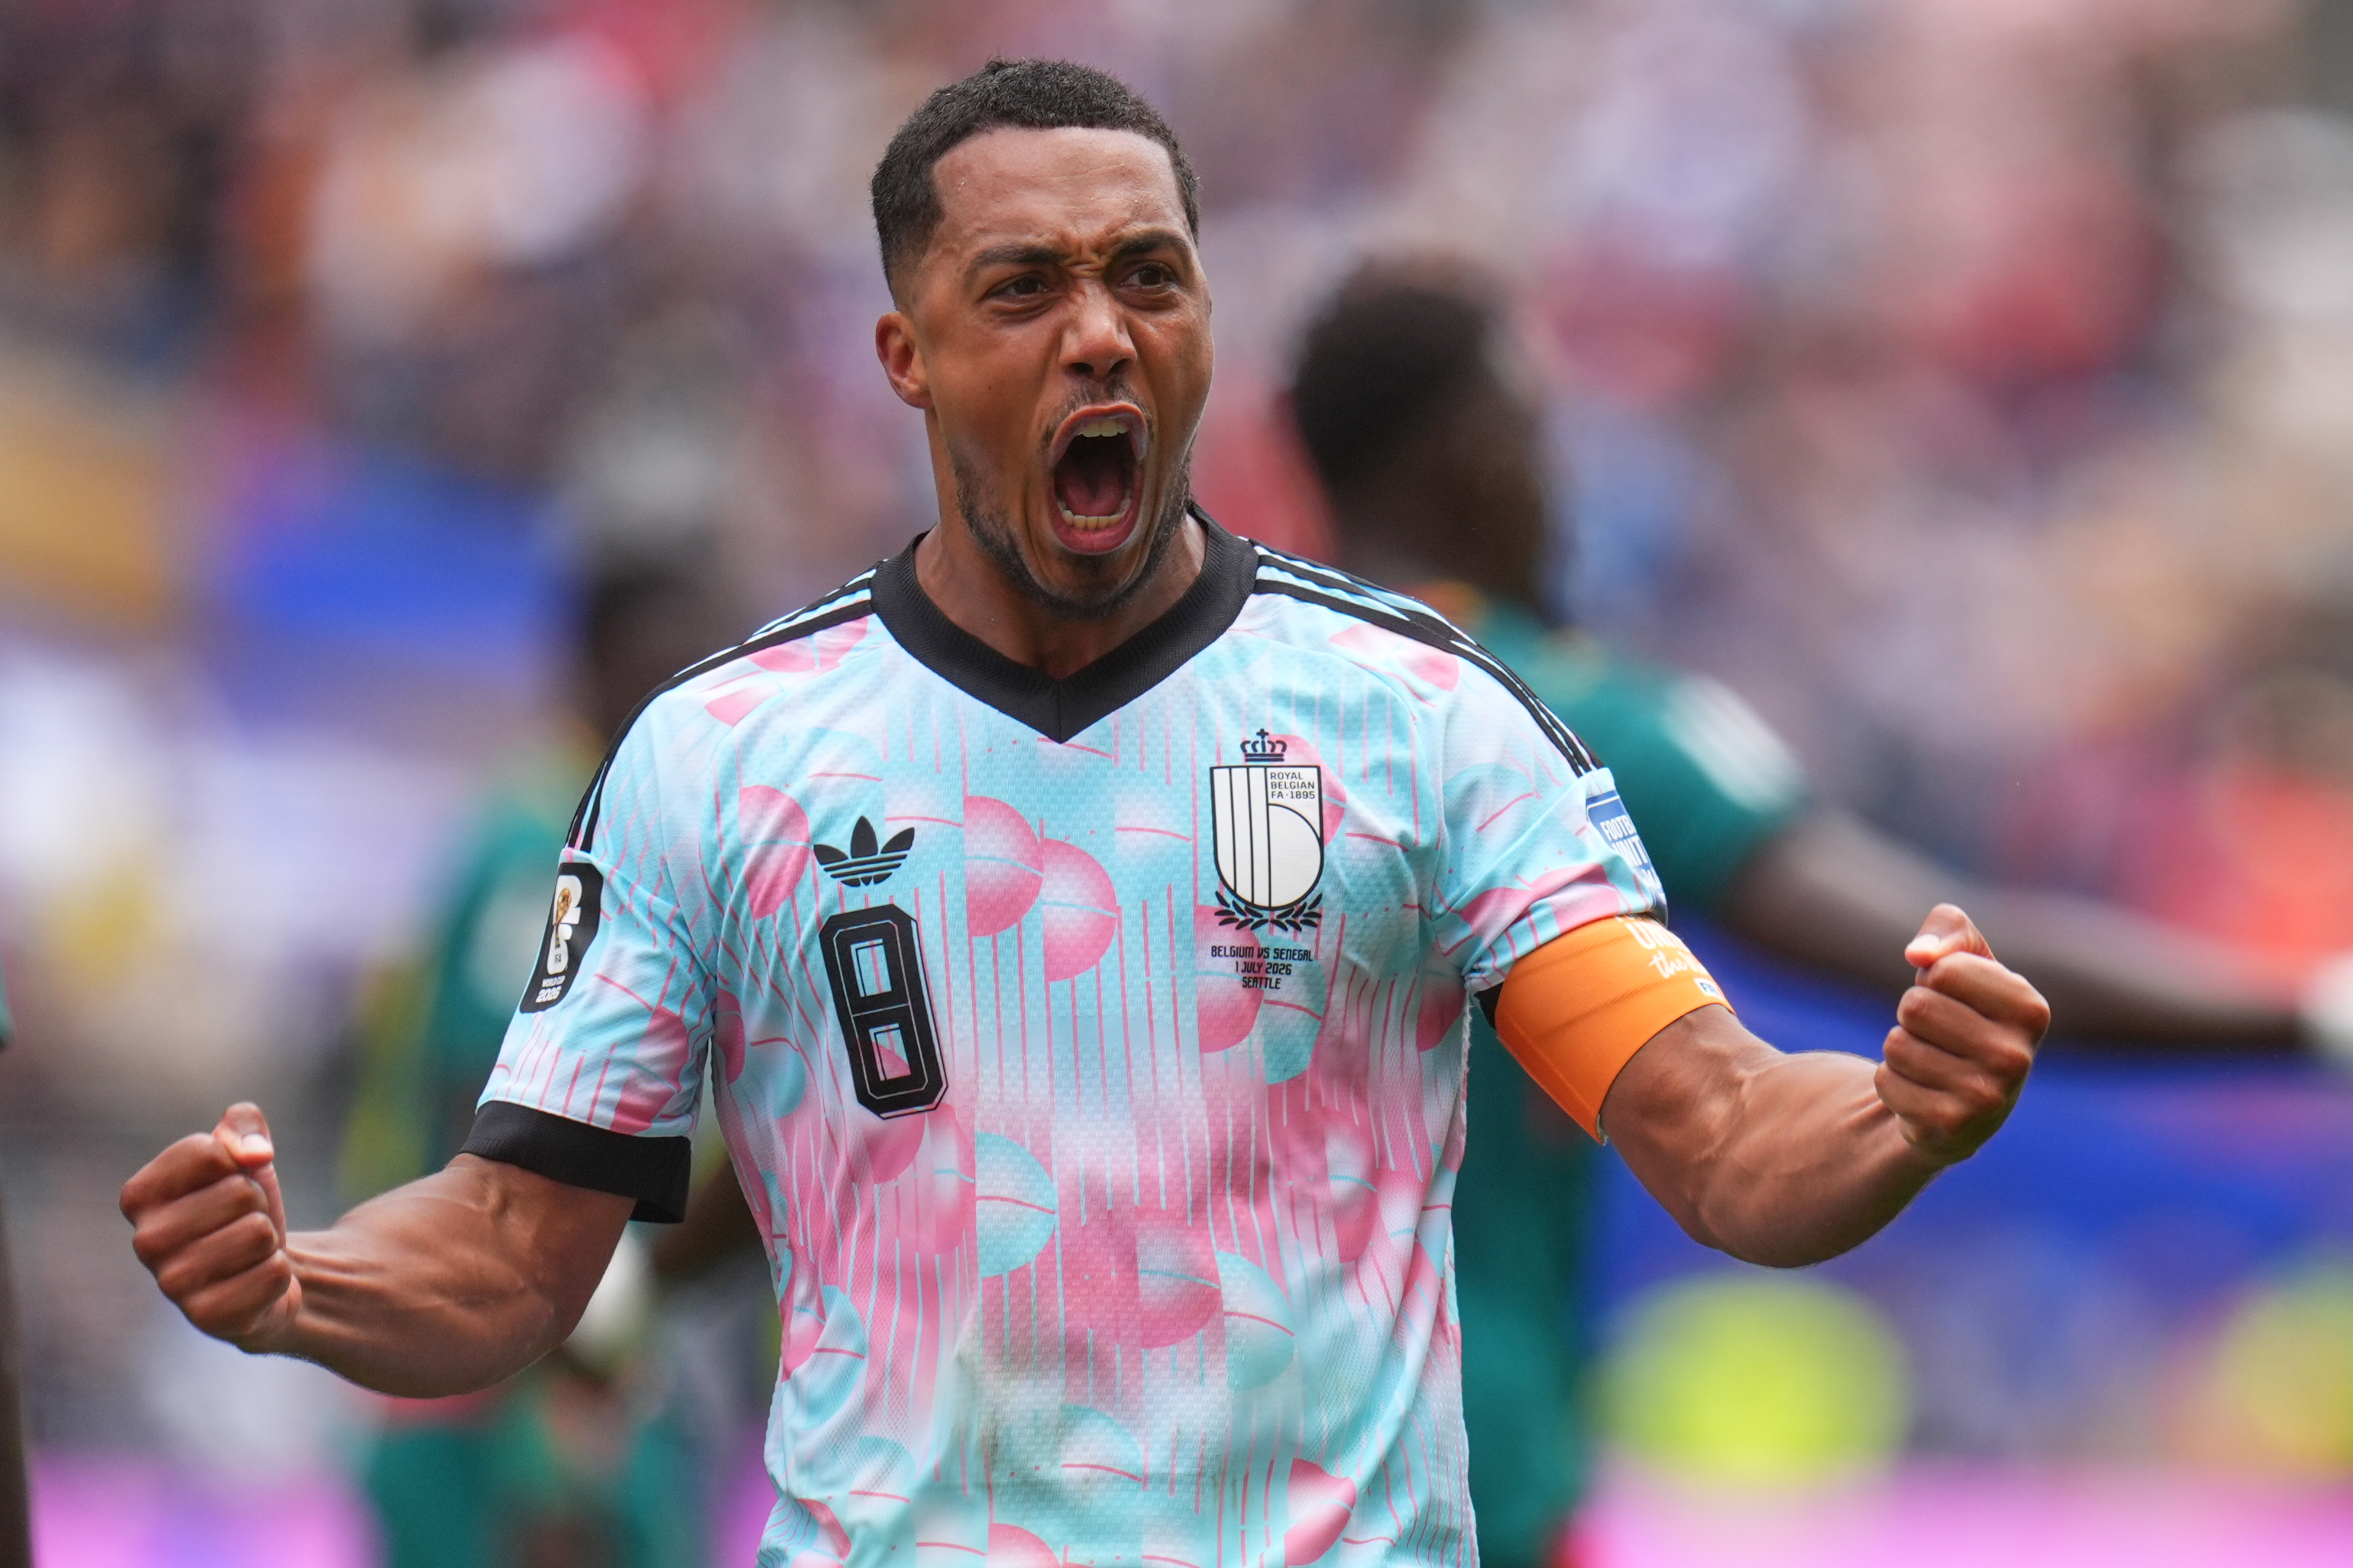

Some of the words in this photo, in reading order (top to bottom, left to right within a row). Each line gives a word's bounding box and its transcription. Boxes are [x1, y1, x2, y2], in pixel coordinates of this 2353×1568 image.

[1270, 772, 1303, 780] ROYAL
[1271, 781, 1315, 790] BELGIAN
[1211, 945, 1254, 958] BELGIUM
[1256, 947, 1270, 959] VS
[1273, 947, 1314, 962] SENEGAL
[1235, 961, 1239, 973] 1
[1241, 962, 1263, 974] JULY
[1265, 962, 1293, 975] 2026
[1242, 976, 1282, 989] SEATTLE
[535, 986, 561, 1003] 2026
[819, 903, 948, 1120] 8
